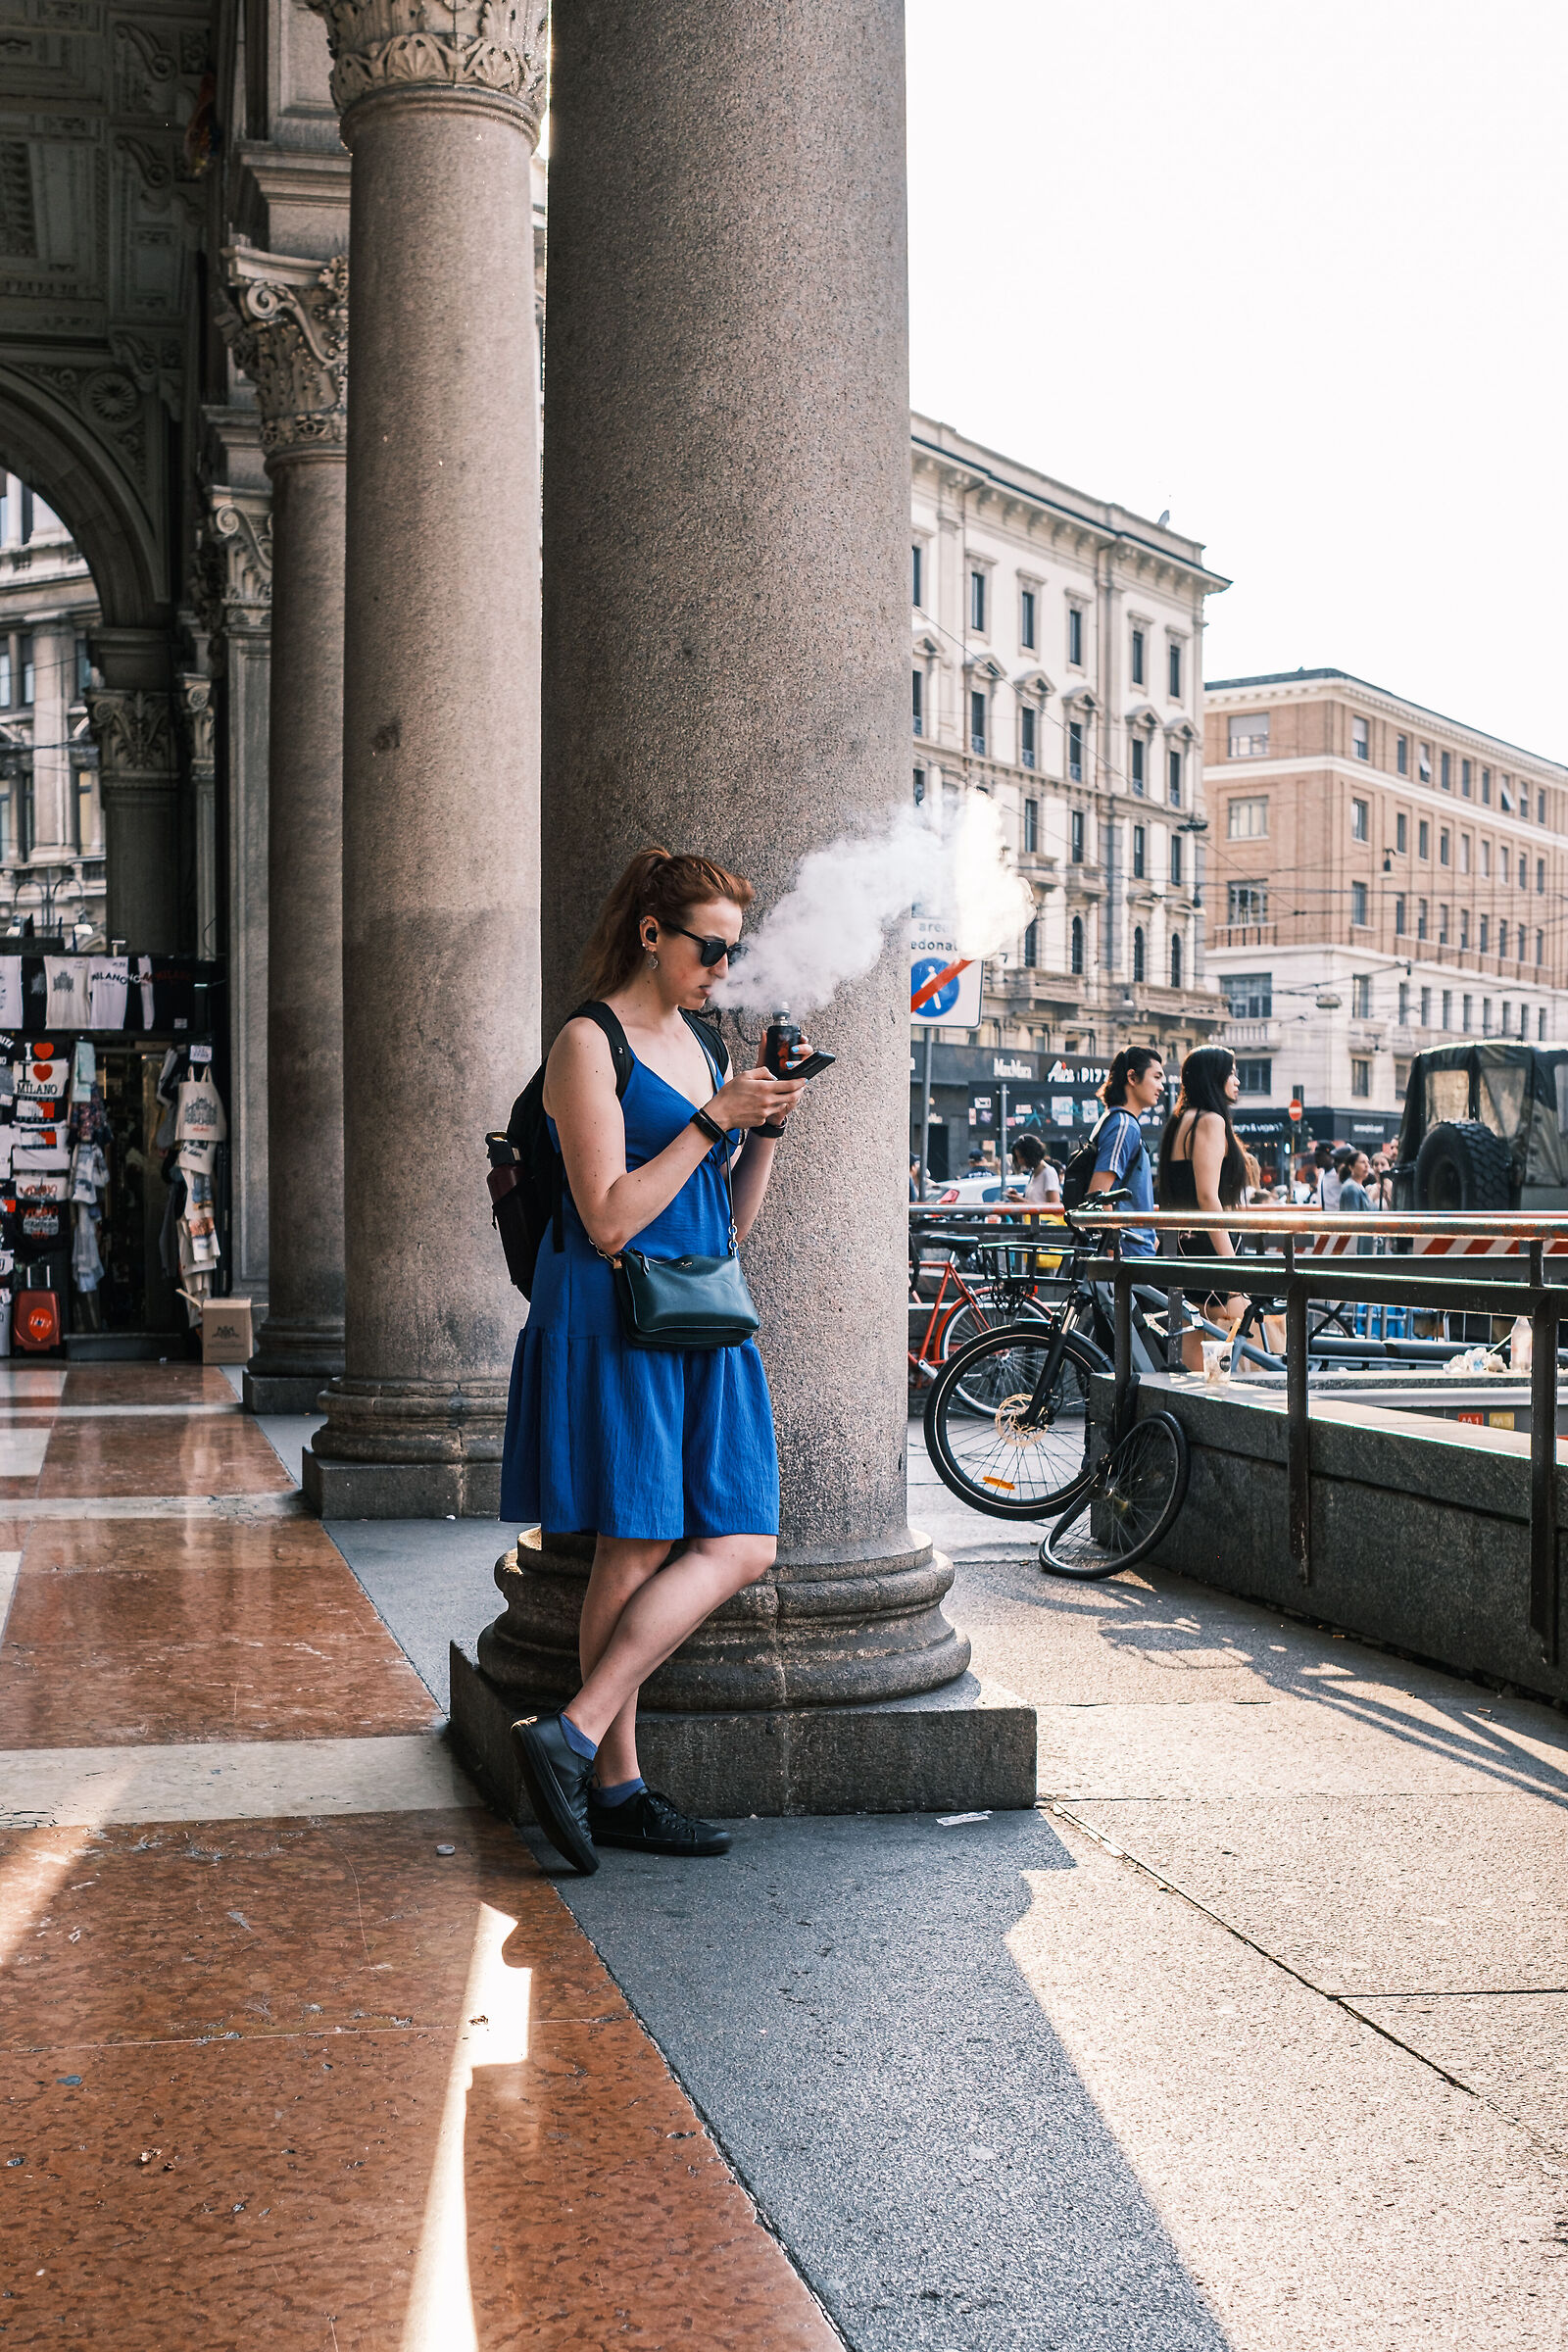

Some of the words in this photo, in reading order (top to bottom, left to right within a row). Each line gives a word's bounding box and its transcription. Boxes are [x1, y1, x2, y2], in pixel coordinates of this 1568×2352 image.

[910, 939, 957, 952] edonal
[18, 1062, 30, 1083] I
[1081, 1066, 1110, 1084] PIZZ
[17, 1083, 58, 1096] MILANO
